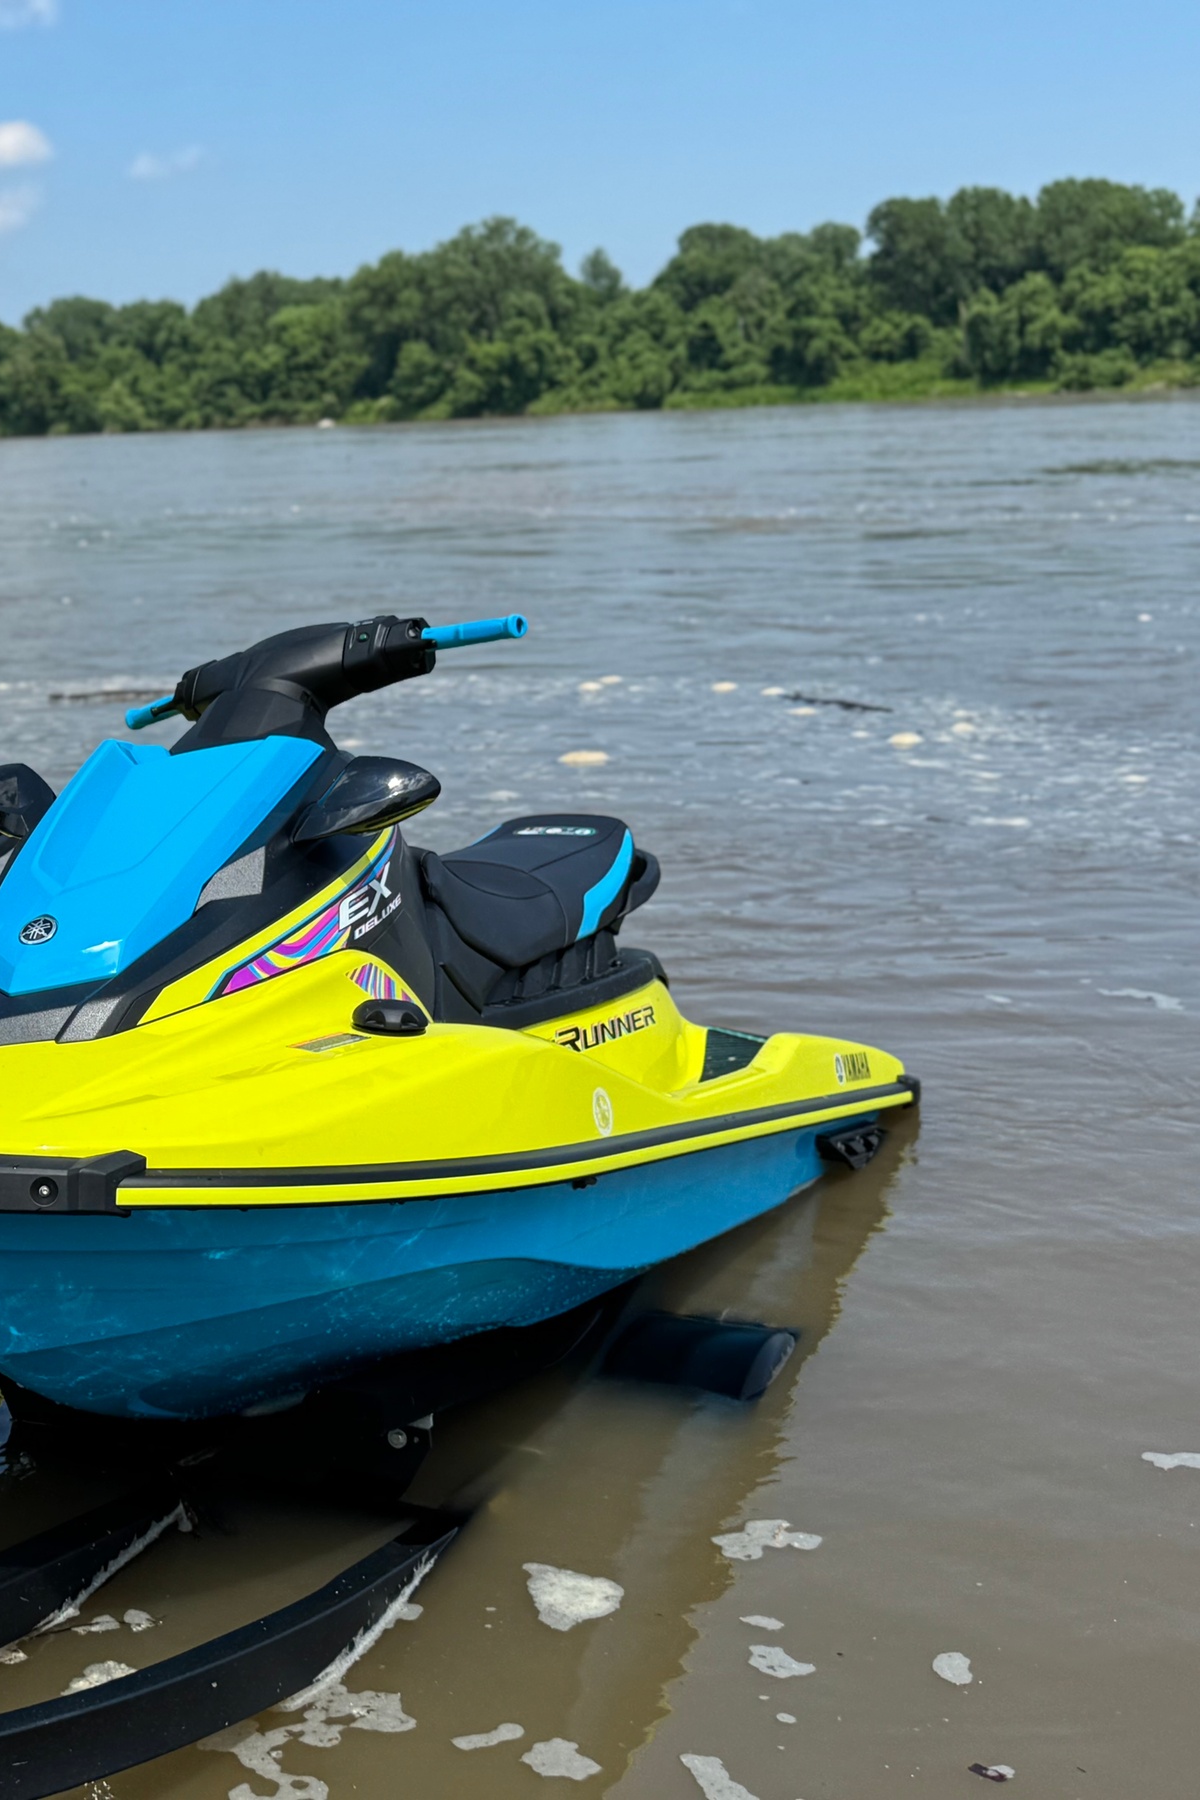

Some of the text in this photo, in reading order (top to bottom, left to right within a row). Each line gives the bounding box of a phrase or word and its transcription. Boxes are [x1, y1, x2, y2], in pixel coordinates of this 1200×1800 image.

[339, 861, 392, 931] EX
[354, 892, 401, 939] DELUXE
[555, 1004, 656, 1052] RUNNER
